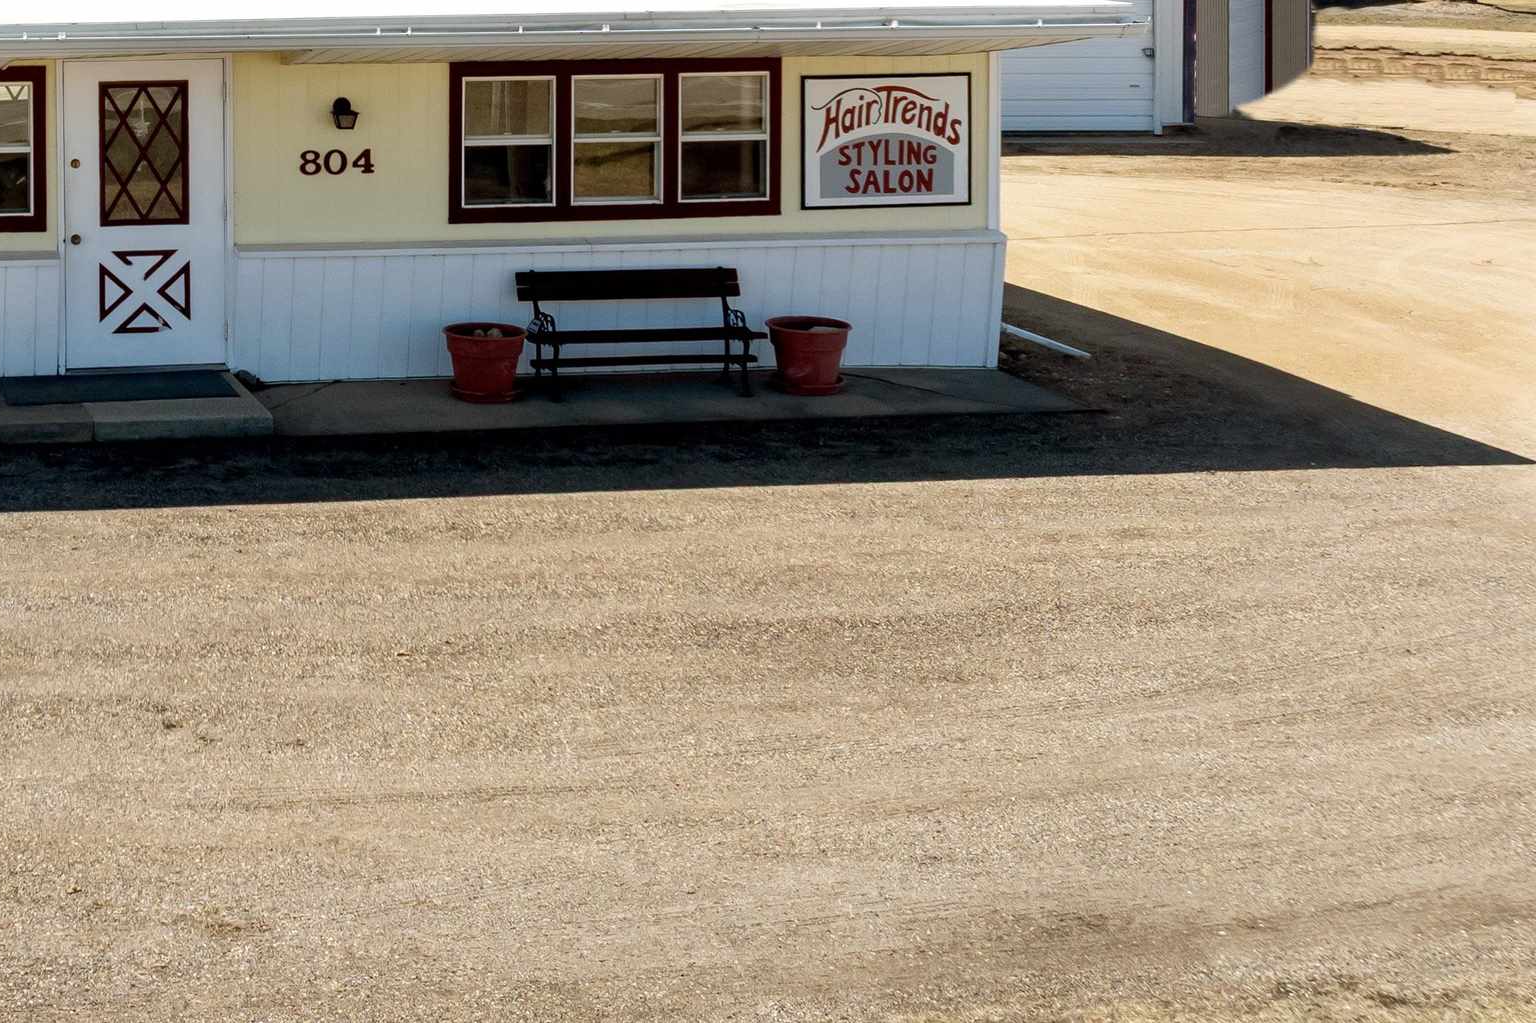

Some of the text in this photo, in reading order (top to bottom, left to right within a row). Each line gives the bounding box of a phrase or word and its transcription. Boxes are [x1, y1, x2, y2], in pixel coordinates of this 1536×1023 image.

[816, 85, 962, 153] Hair Trends
[299, 148, 375, 176] 804
[838, 139, 937, 166] STYLING
[845, 168, 934, 194] SALON
